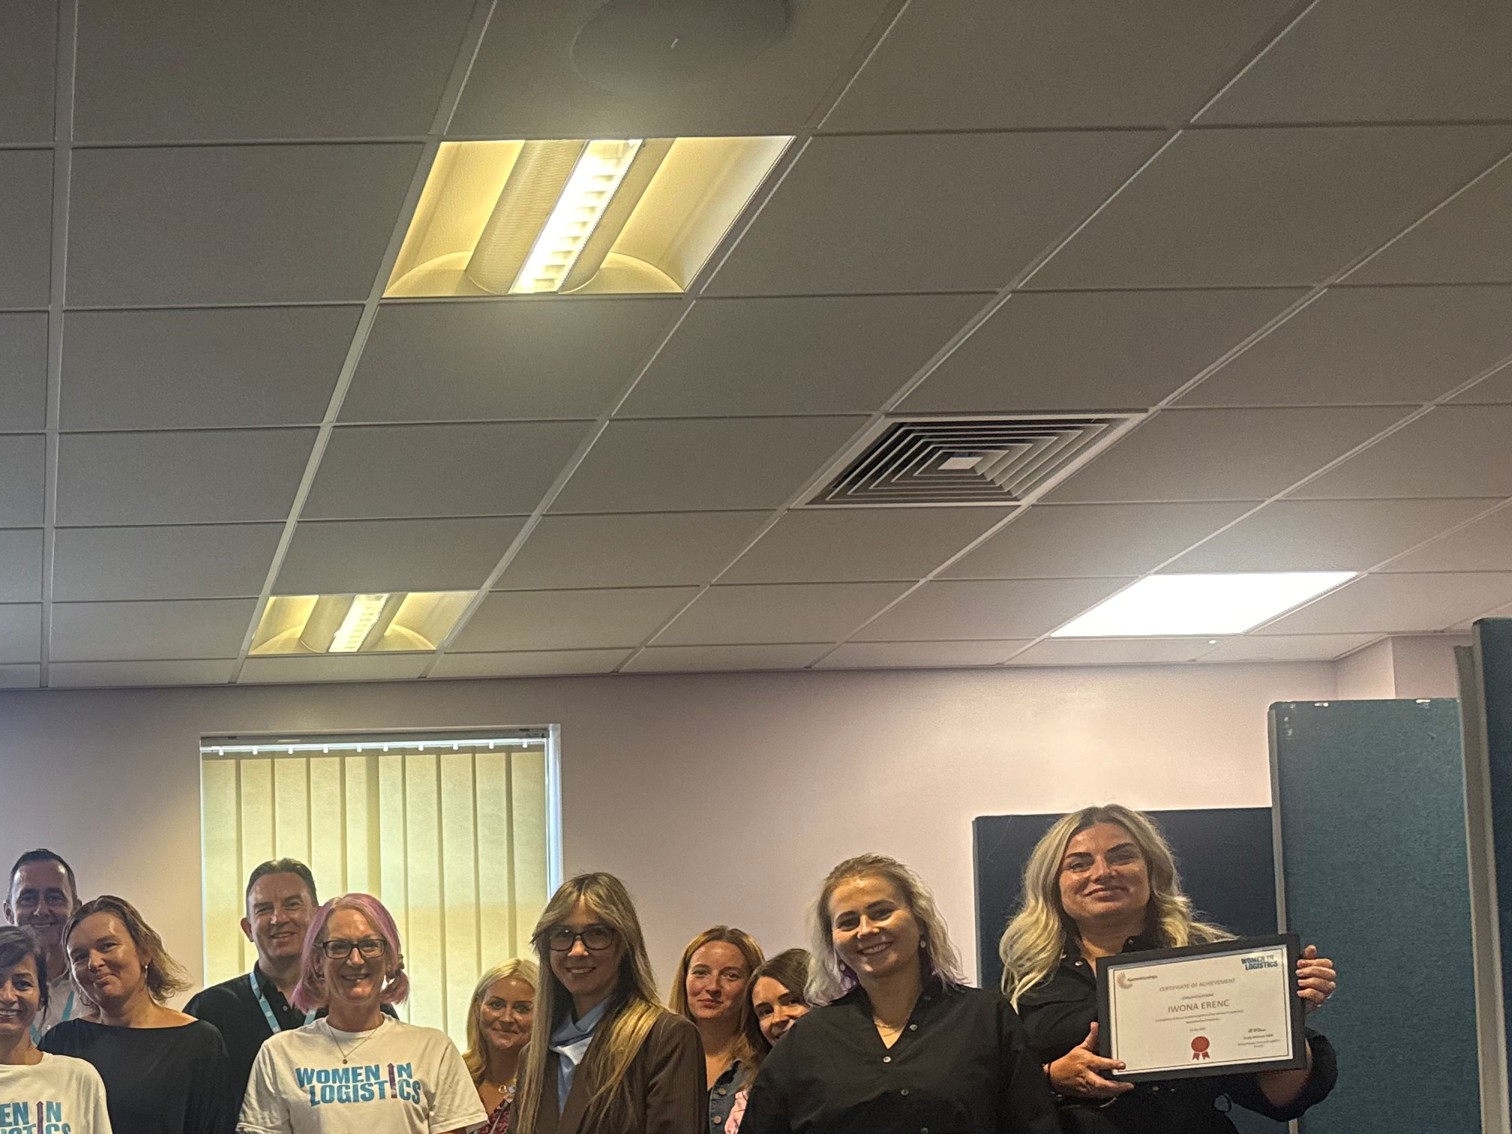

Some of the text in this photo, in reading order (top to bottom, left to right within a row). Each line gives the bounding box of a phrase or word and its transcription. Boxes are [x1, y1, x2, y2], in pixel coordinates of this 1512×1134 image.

[1168, 999, 1230, 1014] IWONA ERENC
[295, 1064, 380, 1088] WOMEN
[309, 1078, 422, 1107] LOGISTICS
